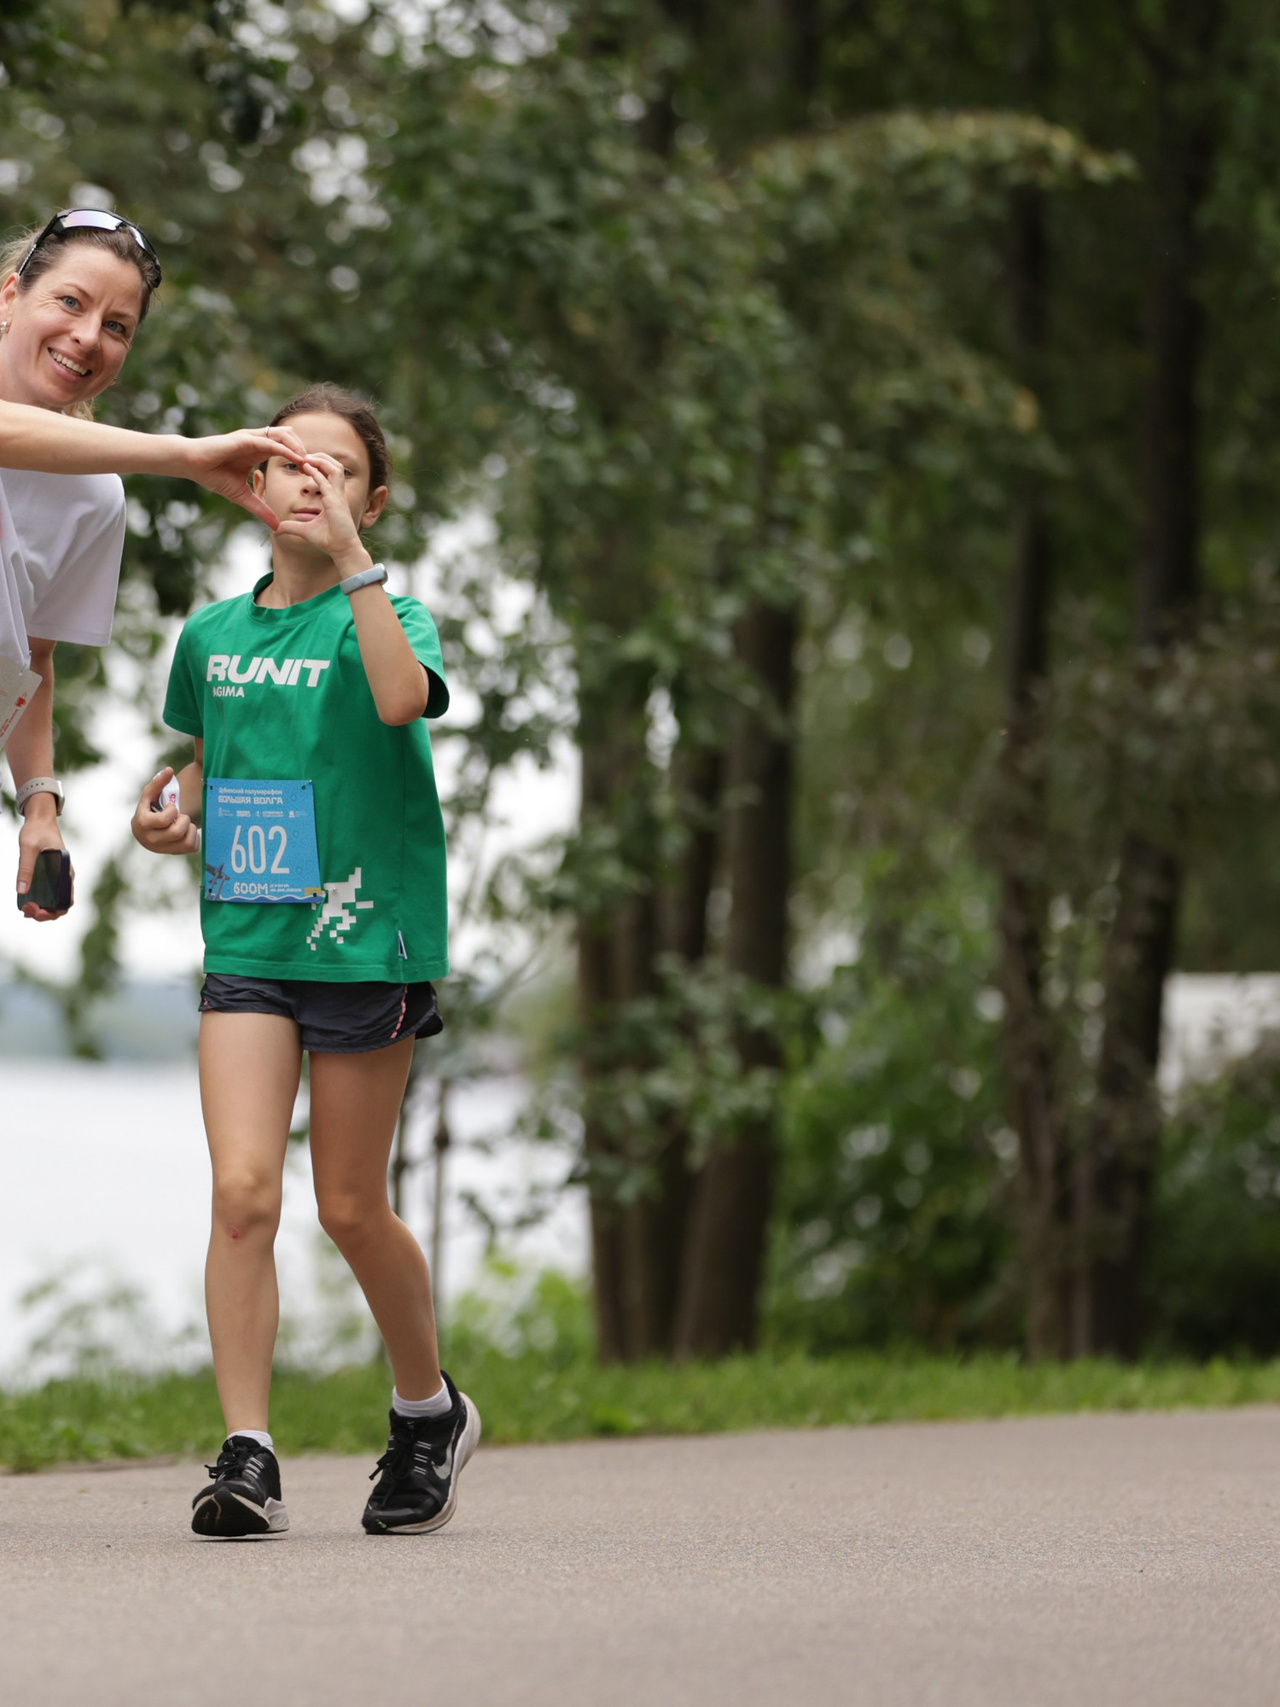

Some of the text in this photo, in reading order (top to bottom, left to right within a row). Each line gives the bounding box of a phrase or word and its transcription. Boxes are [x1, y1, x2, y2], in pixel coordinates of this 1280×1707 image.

[206, 654, 331, 687] RUNIT
[218, 795, 284, 805] БОЛЬШАЯ ВОЛГА
[231, 825, 290, 874] 602
